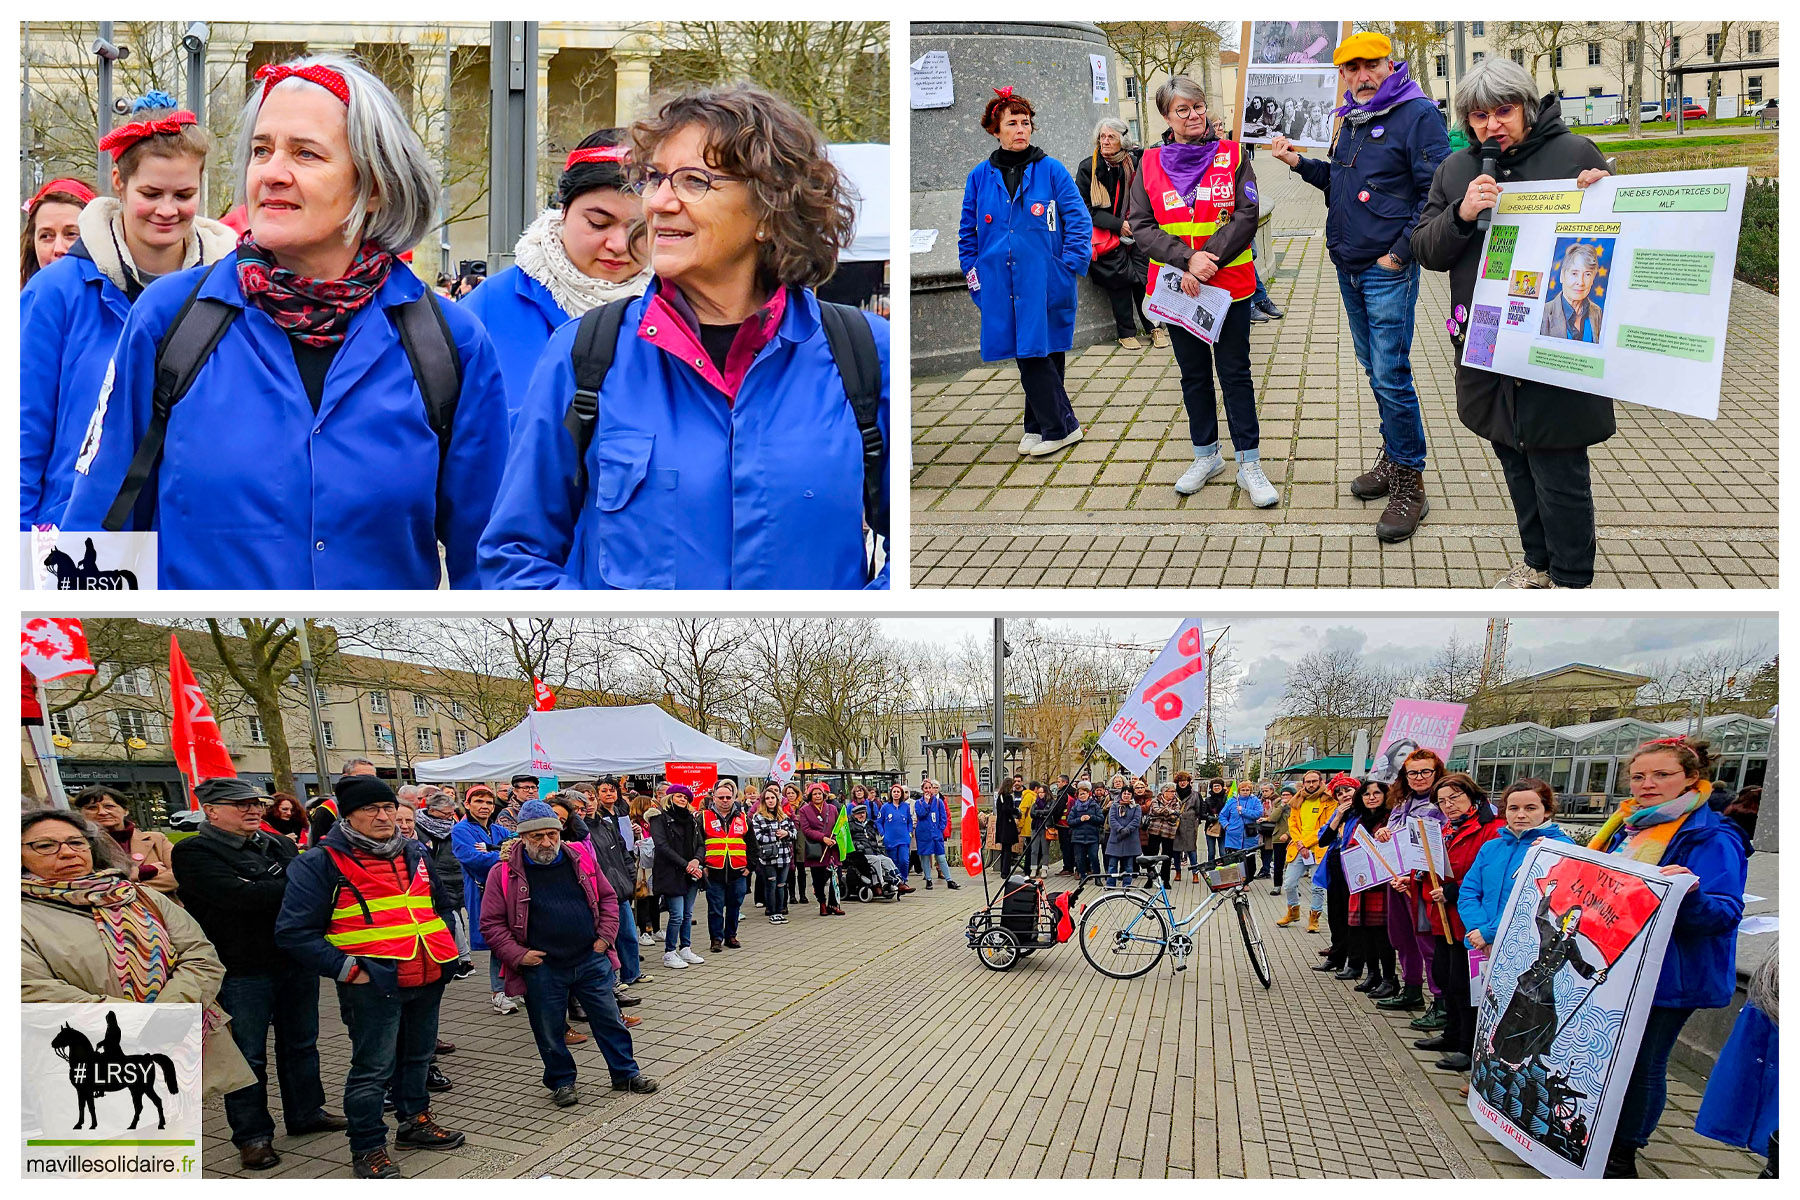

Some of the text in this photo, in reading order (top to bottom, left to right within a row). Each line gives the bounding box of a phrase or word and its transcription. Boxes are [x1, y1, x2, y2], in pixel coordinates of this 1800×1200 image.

[1212, 182, 1234, 198] cgt
[1619, 190, 1634, 198] UNE
[1713, 187, 1726, 195] DU
[1556, 224, 1593, 232] CHRISTINE
[1392, 714, 1409, 731] LA
[1409, 716, 1455, 737] CAUSE
[1112, 716, 1158, 758] attac
[1388, 730, 1449, 750] DES FEMMES
[60, 771, 92, 779] Quartier
[532, 760, 552, 770] attac
[1597, 870, 1624, 895] VIVE
[1570, 879, 1620, 929] LA COMMUNE
[1476, 1100, 1533, 1152] LOUISE MICHEL
